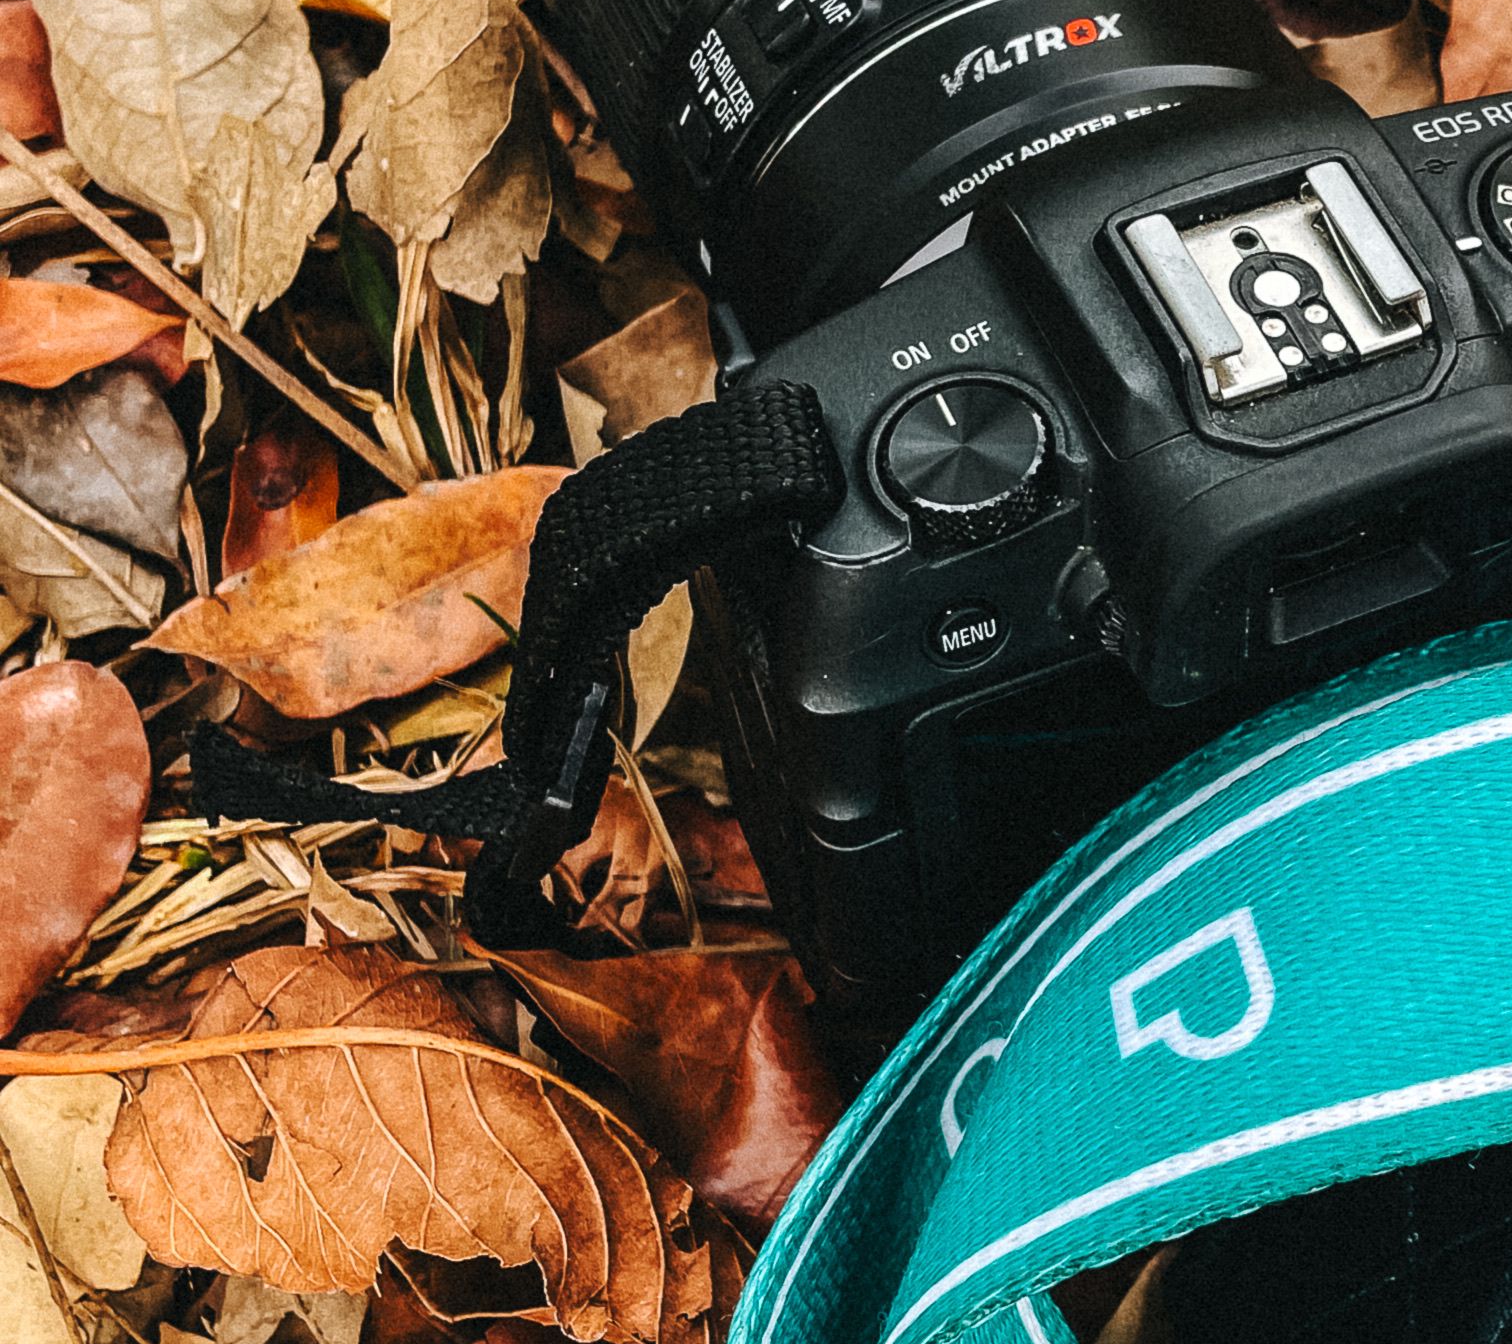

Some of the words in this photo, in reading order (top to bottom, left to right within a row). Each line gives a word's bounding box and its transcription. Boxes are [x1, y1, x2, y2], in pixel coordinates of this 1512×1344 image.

[689, 49, 710, 83] ON
[714, 97, 738, 133] OFF
[701, 28, 755, 124] STABILIZER
[940, 13, 1124, 98] VILTROX
[938, 152, 1015, 207] MOUNT
[1020, 114, 1117, 162] ADAPTER
[1412, 111, 1482, 143] EOS
[892, 341, 932, 370] ON
[950, 320, 992, 354] OFF
[942, 618, 997, 653] MENU
